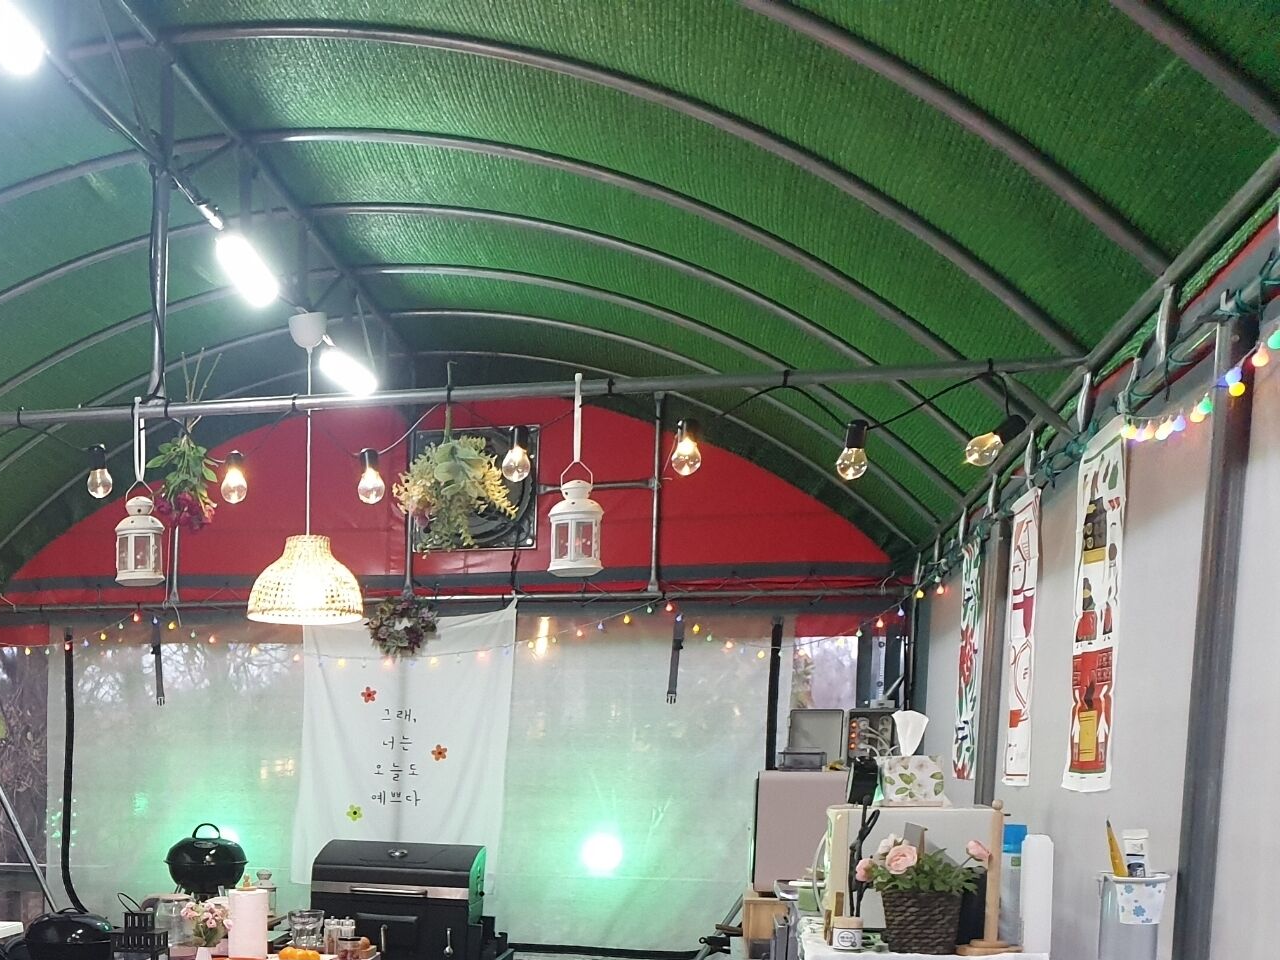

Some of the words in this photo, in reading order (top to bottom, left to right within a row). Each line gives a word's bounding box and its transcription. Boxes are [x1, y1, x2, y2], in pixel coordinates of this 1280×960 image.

[381, 708, 417, 723] 그래,
[382, 735, 412, 751] 너는
[373, 762, 419, 781] 오늘도
[371, 789, 421, 806] 예쁘다
